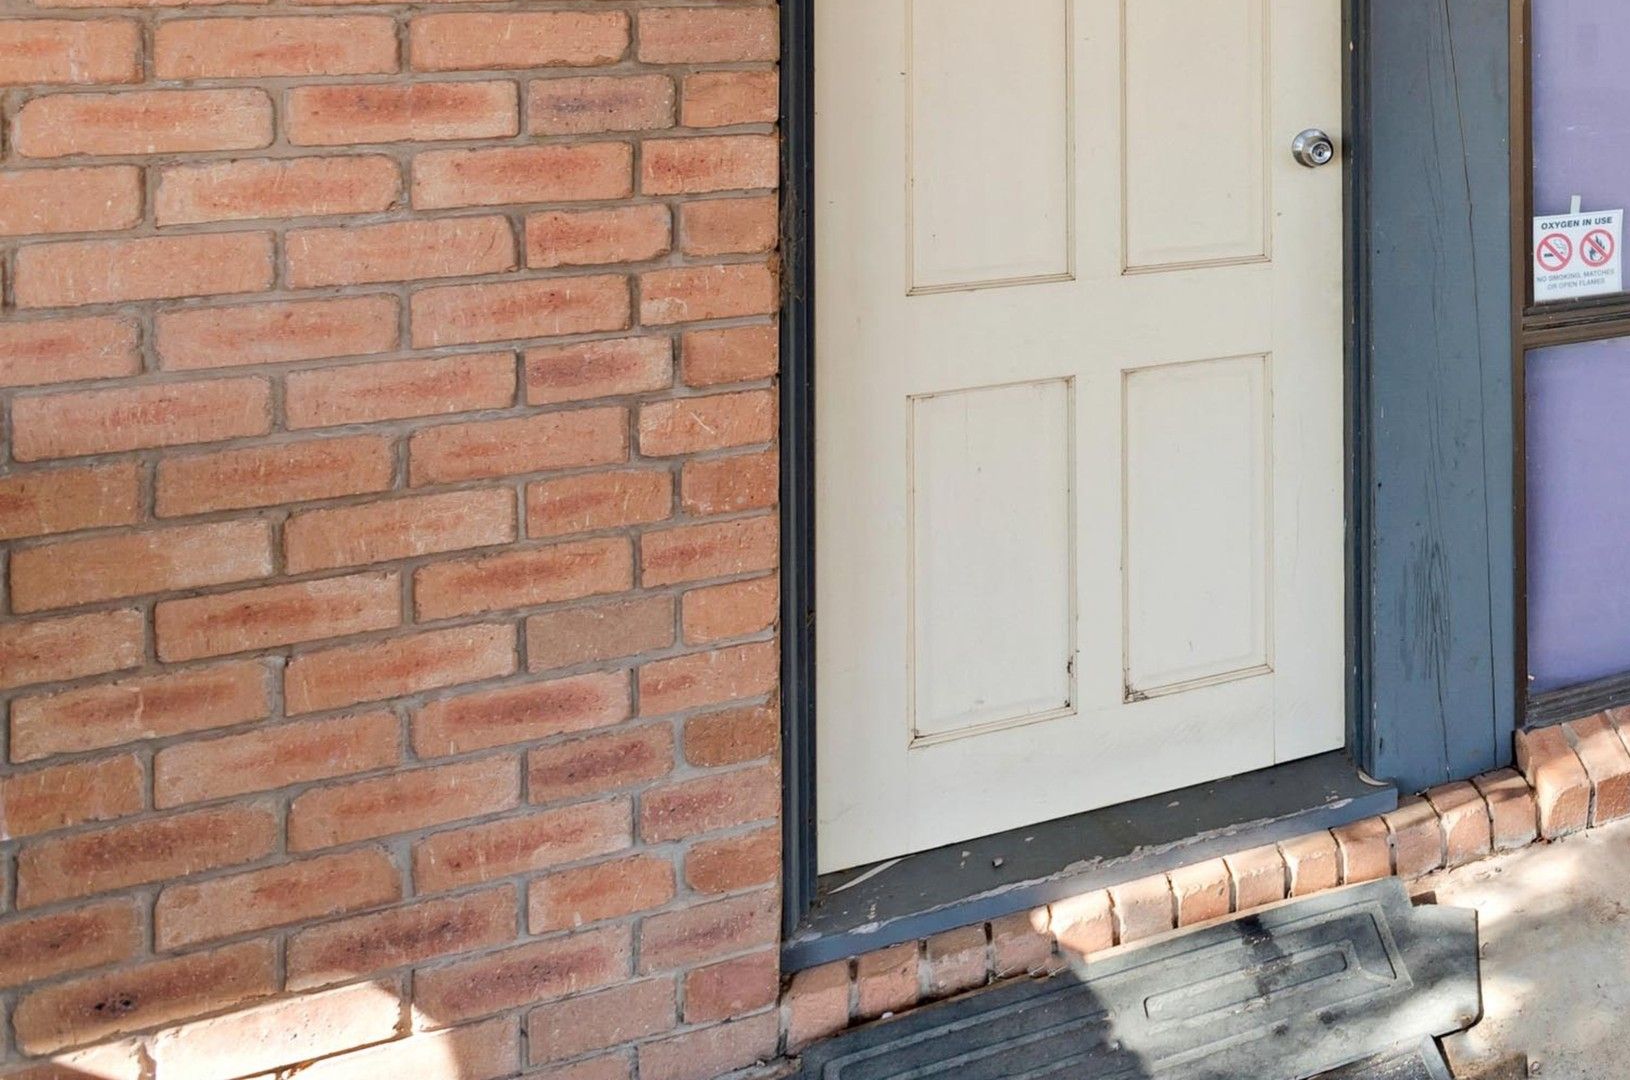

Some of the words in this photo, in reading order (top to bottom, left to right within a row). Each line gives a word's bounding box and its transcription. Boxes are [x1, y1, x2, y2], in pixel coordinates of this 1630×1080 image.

[1541, 220, 1580, 230] OXYGEN
[1595, 216, 1613, 225] USE
[1583, 269, 1615, 277] MATCHES
[1558, 281, 1578, 289] OPEN
